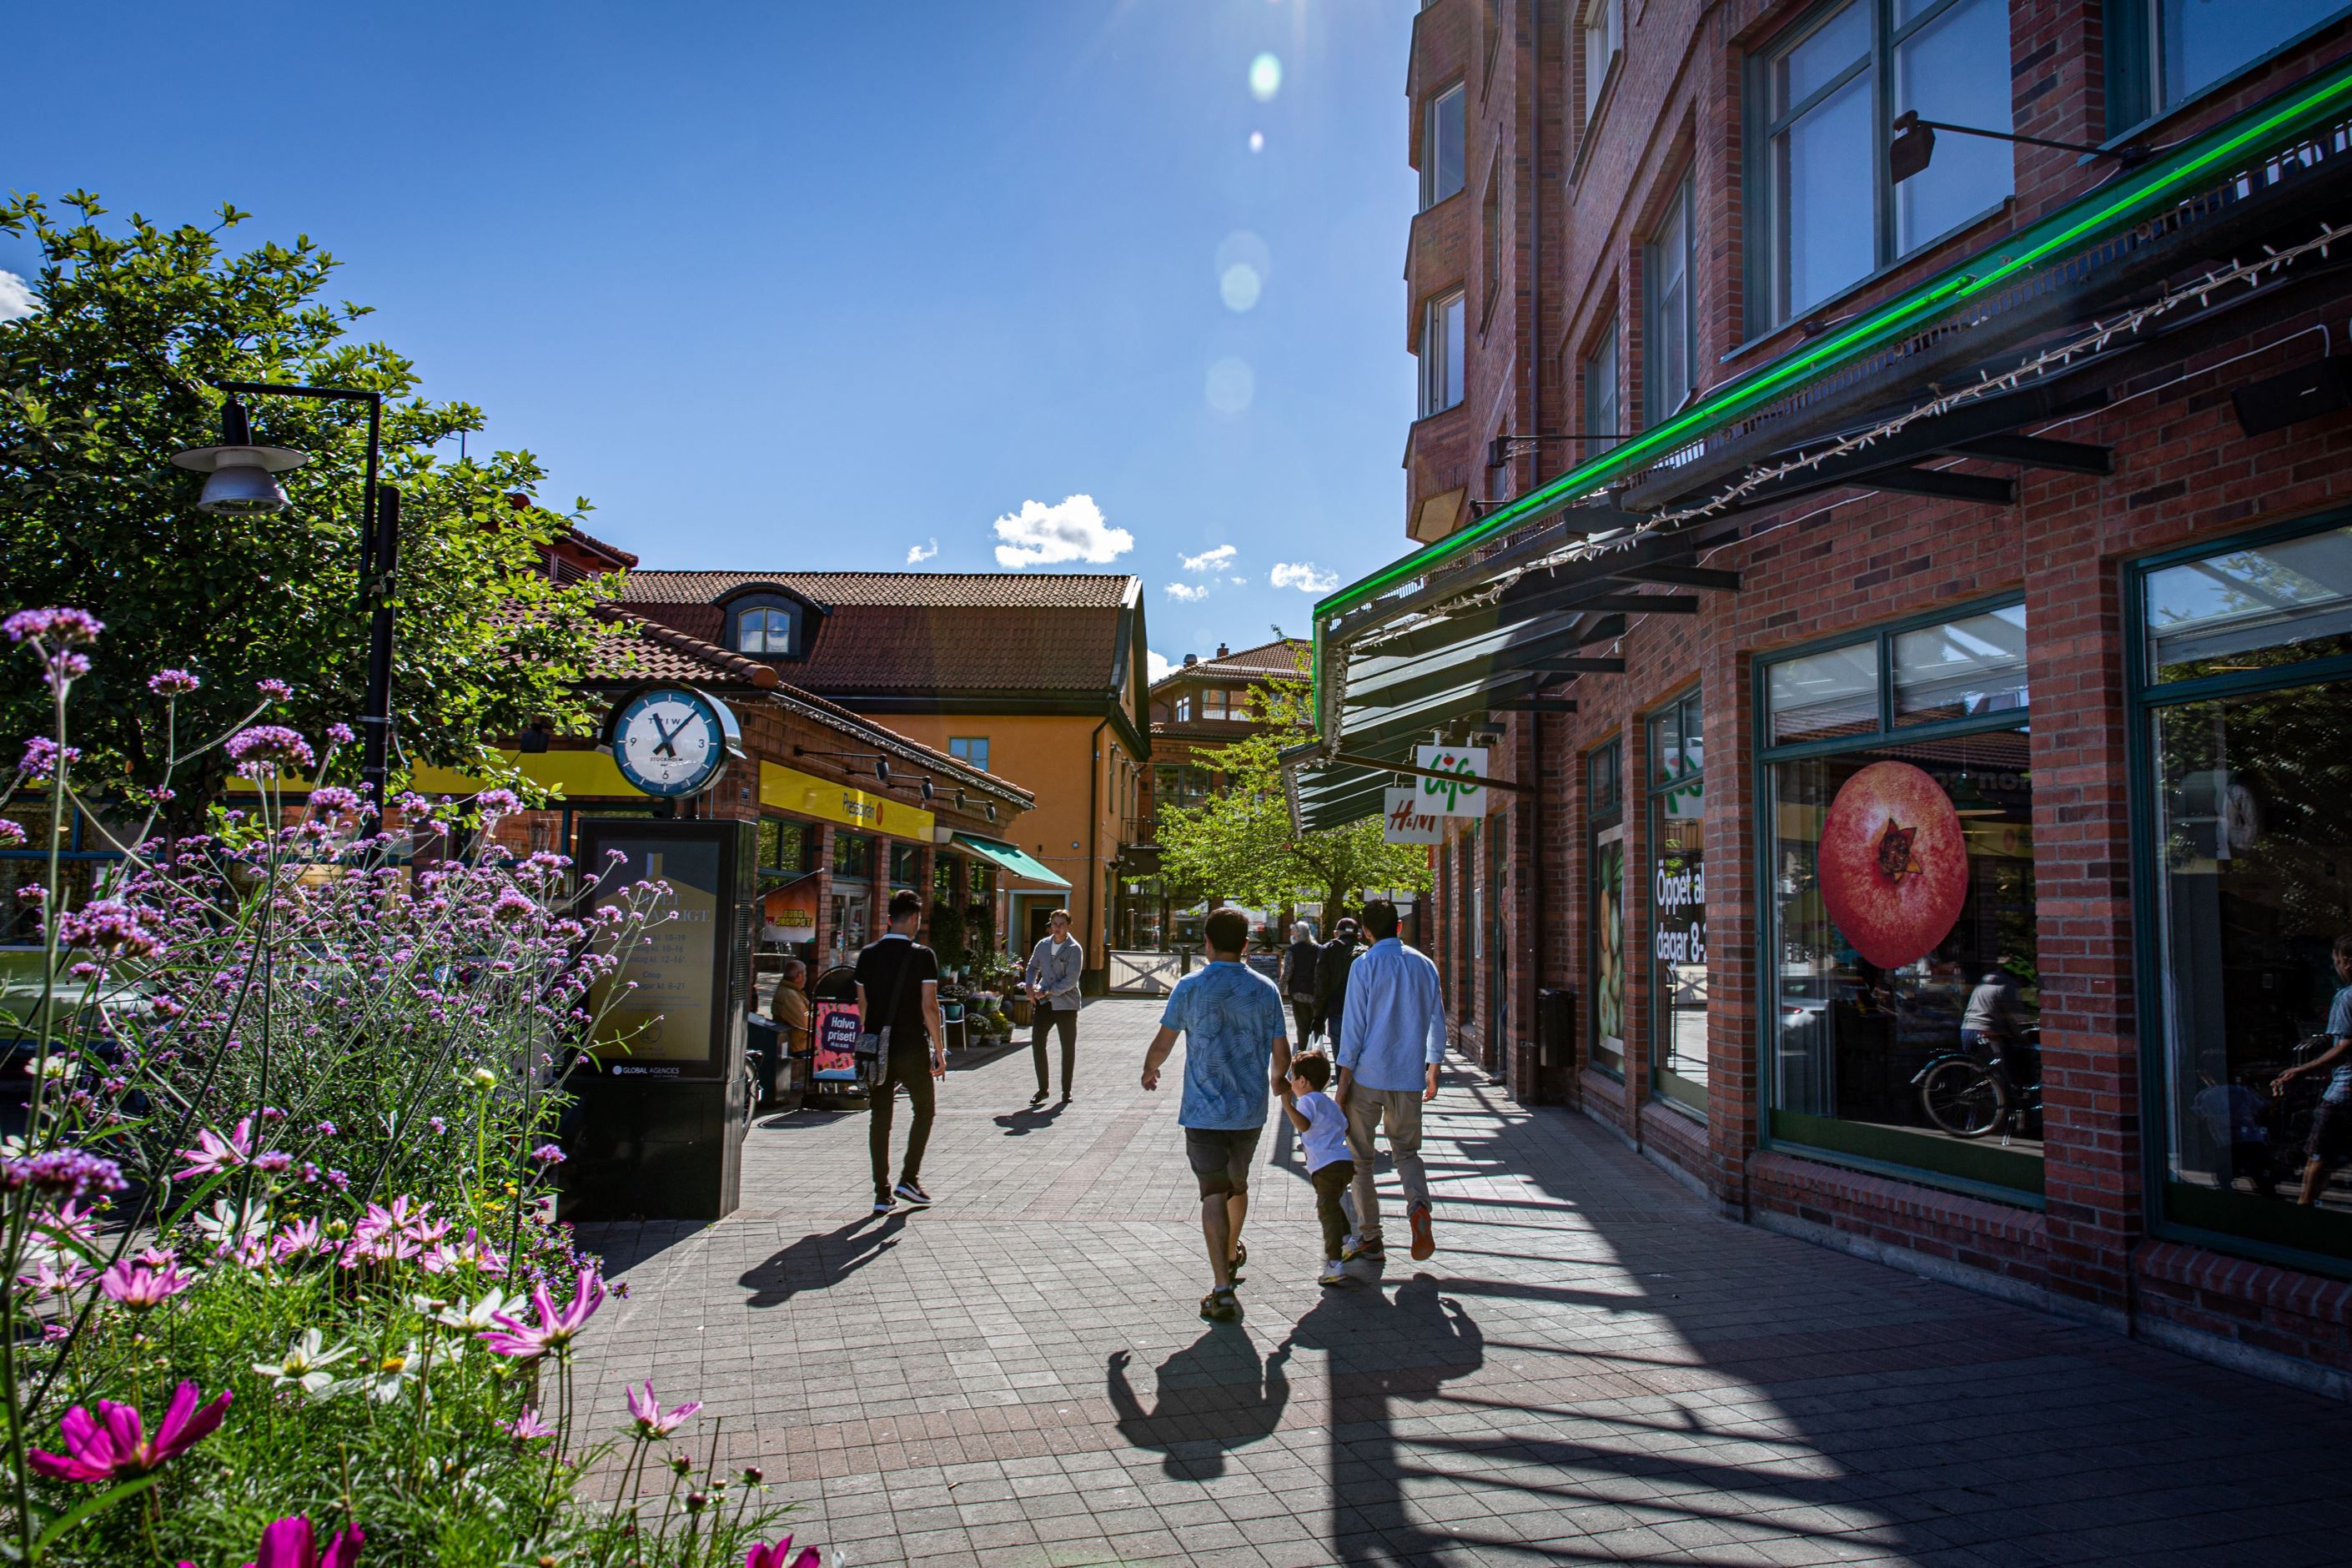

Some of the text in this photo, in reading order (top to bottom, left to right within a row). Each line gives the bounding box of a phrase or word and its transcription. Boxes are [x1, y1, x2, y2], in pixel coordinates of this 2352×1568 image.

[630, 737, 637, 746] 9
[698, 739, 706, 748] 3
[662, 770, 669, 780] 6
[1390, 800, 1436, 832] H&M
[1656, 859, 1691, 915] Öppet
[783, 909, 804, 918] EURO
[775, 917, 812, 927] JACKPOT
[1656, 922, 1688, 970] dagar
[831, 1017, 856, 1029] Halva
[827, 1030, 856, 1043] priset!
